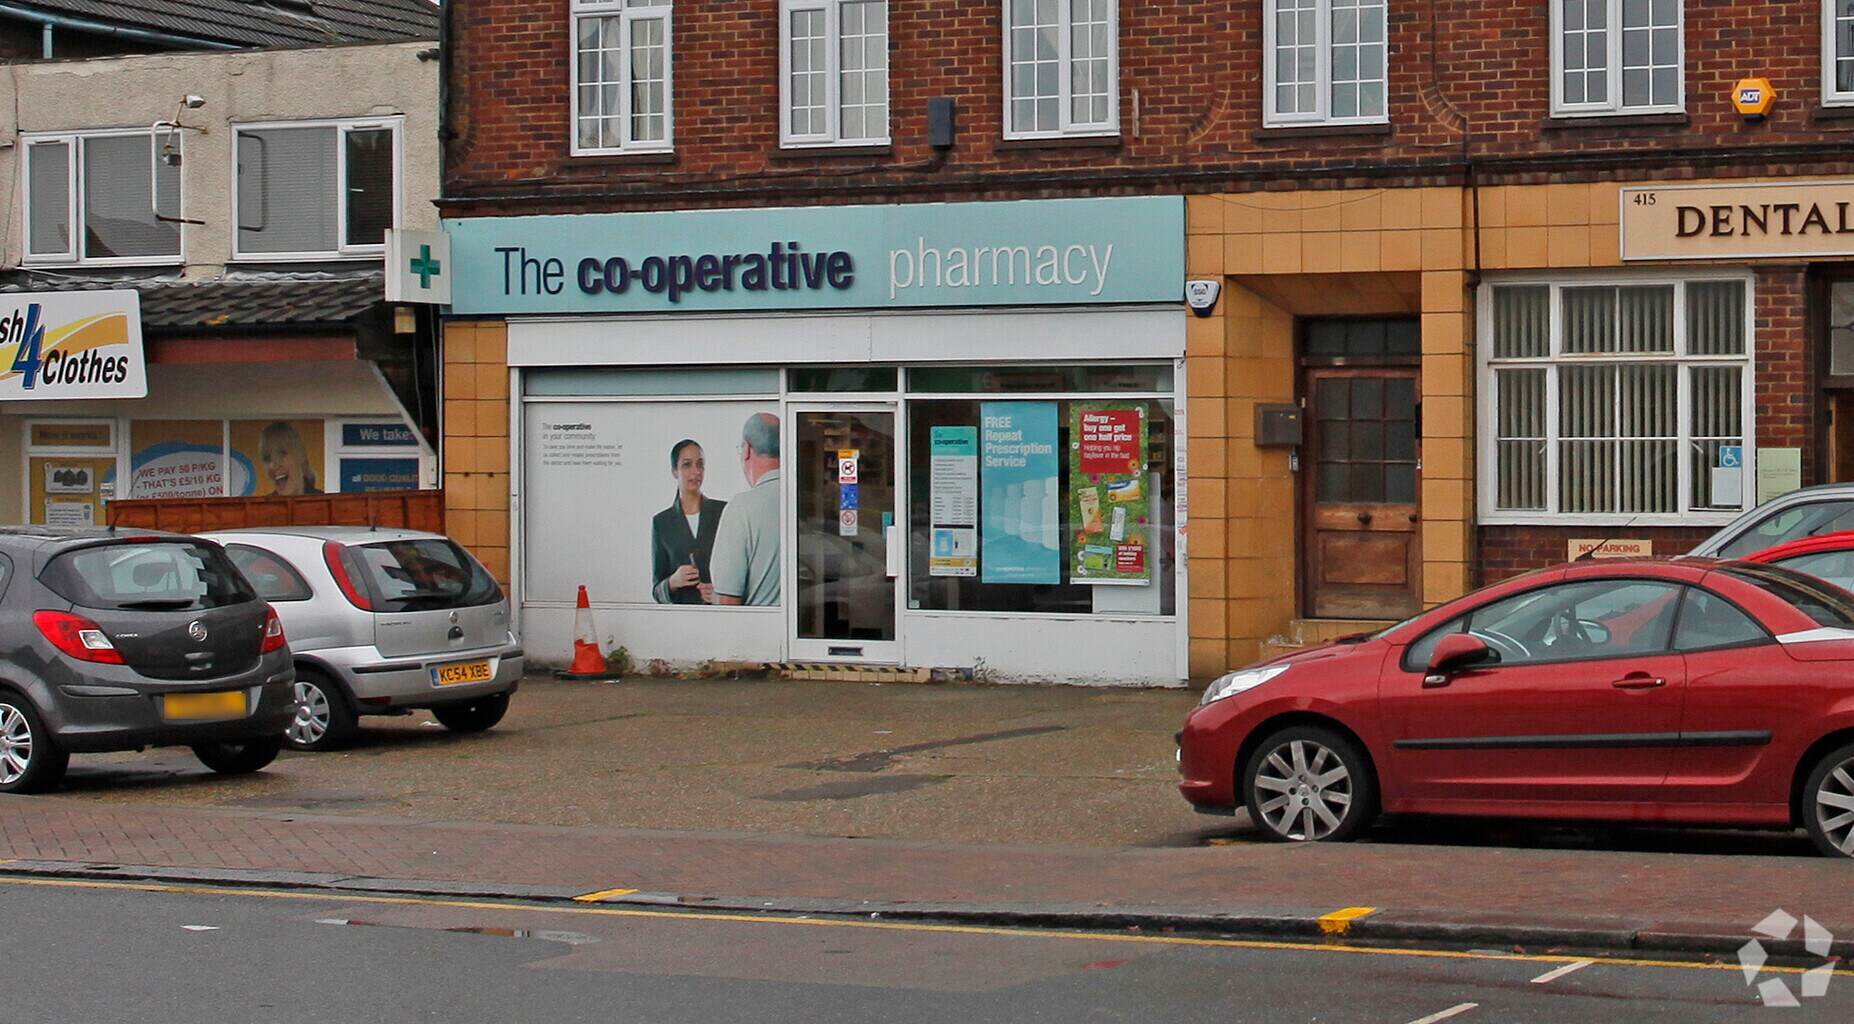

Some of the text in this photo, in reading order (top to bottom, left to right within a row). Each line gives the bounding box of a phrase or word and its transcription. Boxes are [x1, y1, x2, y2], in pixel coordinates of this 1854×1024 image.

[1741, 91, 1760, 102] ADT
[1633, 193, 1656, 206] 415
[1674, 202, 1854, 238] DENTAL
[494, 236, 1114, 303] The co-operative pharmacy
[11, 303, 46, 390] 4
[42, 349, 129, 385] Clothes
[985, 416, 1011, 428] FREE
[1083, 414, 1109, 424] Allergy
[553, 423, 592, 432] co-operative
[1084, 424, 1097, 433] buy
[360, 429, 380, 441] We
[985, 429, 1022, 443] Repeat
[1113, 433, 1132, 443] price
[985, 443, 1052, 456] Prescription
[985, 455, 1026, 467] Service
[140, 468, 156, 478] WE
[157, 467, 176, 476] PAY
[179, 464, 190, 474] 50
[206, 473, 221, 484] KG
[1597, 544, 1640, 553] PARKING
[438, 664, 489, 682] KC54 XBE
